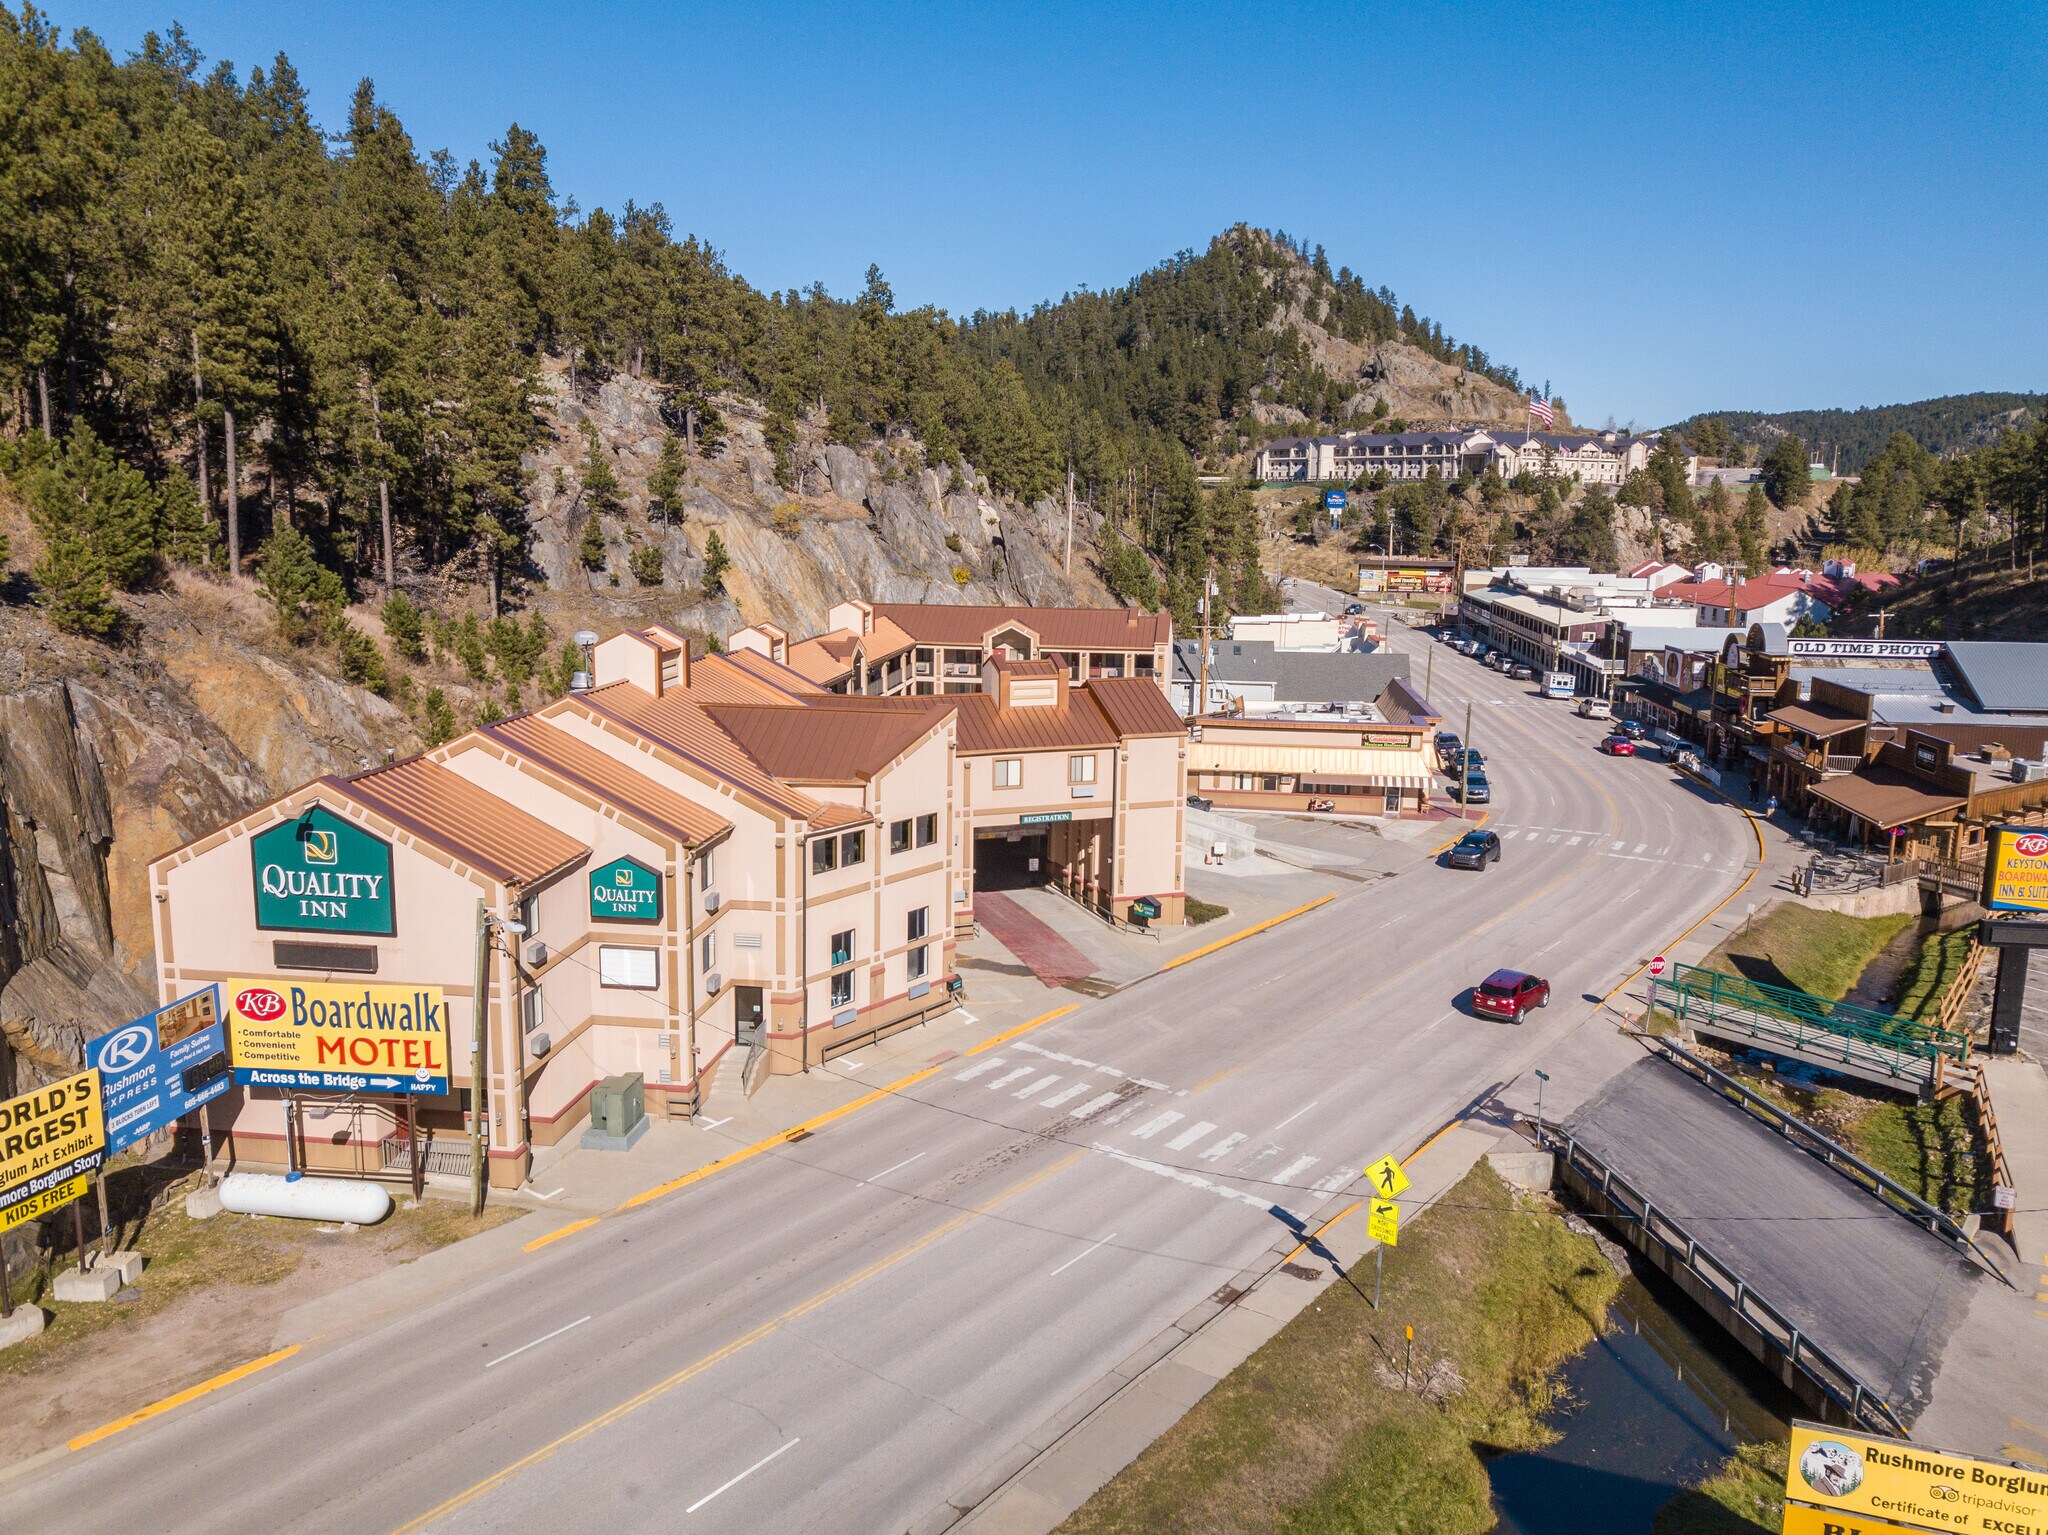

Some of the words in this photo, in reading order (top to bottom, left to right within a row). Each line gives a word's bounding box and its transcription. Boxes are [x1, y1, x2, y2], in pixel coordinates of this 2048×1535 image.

[1794, 643, 1826, 653] OLD
[1830, 643, 1873, 654] TIME
[1877, 644, 1934, 656] PHOTO
[1024, 813, 1070, 823] REGISTRATION
[2020, 838, 2048, 853] KB
[262, 864, 383, 900] QUALITY
[1999, 884, 2016, 897] INN
[2018, 887, 2026, 897] &
[2028, 885, 2048, 899] SUIT
[594, 885, 655, 903] QUALITY
[300, 900, 347, 918] INN
[613, 903, 637, 912] INN
[1650, 961, 1665, 970] STOP
[239, 992, 281, 1016] KB
[290, 986, 441, 1033] Boardwalk
[242, 1029, 301, 1039] Comfortable
[243, 1040, 296, 1050] Convenient
[170, 1043, 190, 1059] Family
[191, 1034, 210, 1049] Suites
[244, 1051, 301, 1062] Competitive
[316, 1035, 442, 1070] MOTEL
[102, 1063, 156, 1099] Rushmore
[250, 1070, 301, 1085] Across
[303, 1072, 320, 1085] the
[323, 1073, 367, 1090] Bridge
[410, 1083, 436, 1092] HAPPY
[103, 1076, 157, 1112] EXPRESS
[111, 1121, 116, 1129] 3
[116, 1111, 134, 1127] BLOCKS
[134, 1105, 147, 1117] TURN
[146, 1099, 157, 1110] LEFT
[31, 1152, 49, 1171] Art
[53, 1133, 94, 1160] Exhibit
[29, 1165, 73, 1194] Borglum
[74, 1152, 101, 1174] Story
[6, 1199, 38, 1225] KIDS
[42, 1182, 75, 1208] FREE
[1865, 1446, 1966, 1480] Rushmore
[1871, 1495, 1950, 1522] Certificate
[1953, 1514, 1969, 1525] of
[1962, 1493, 2037, 1517] tripadvisor
